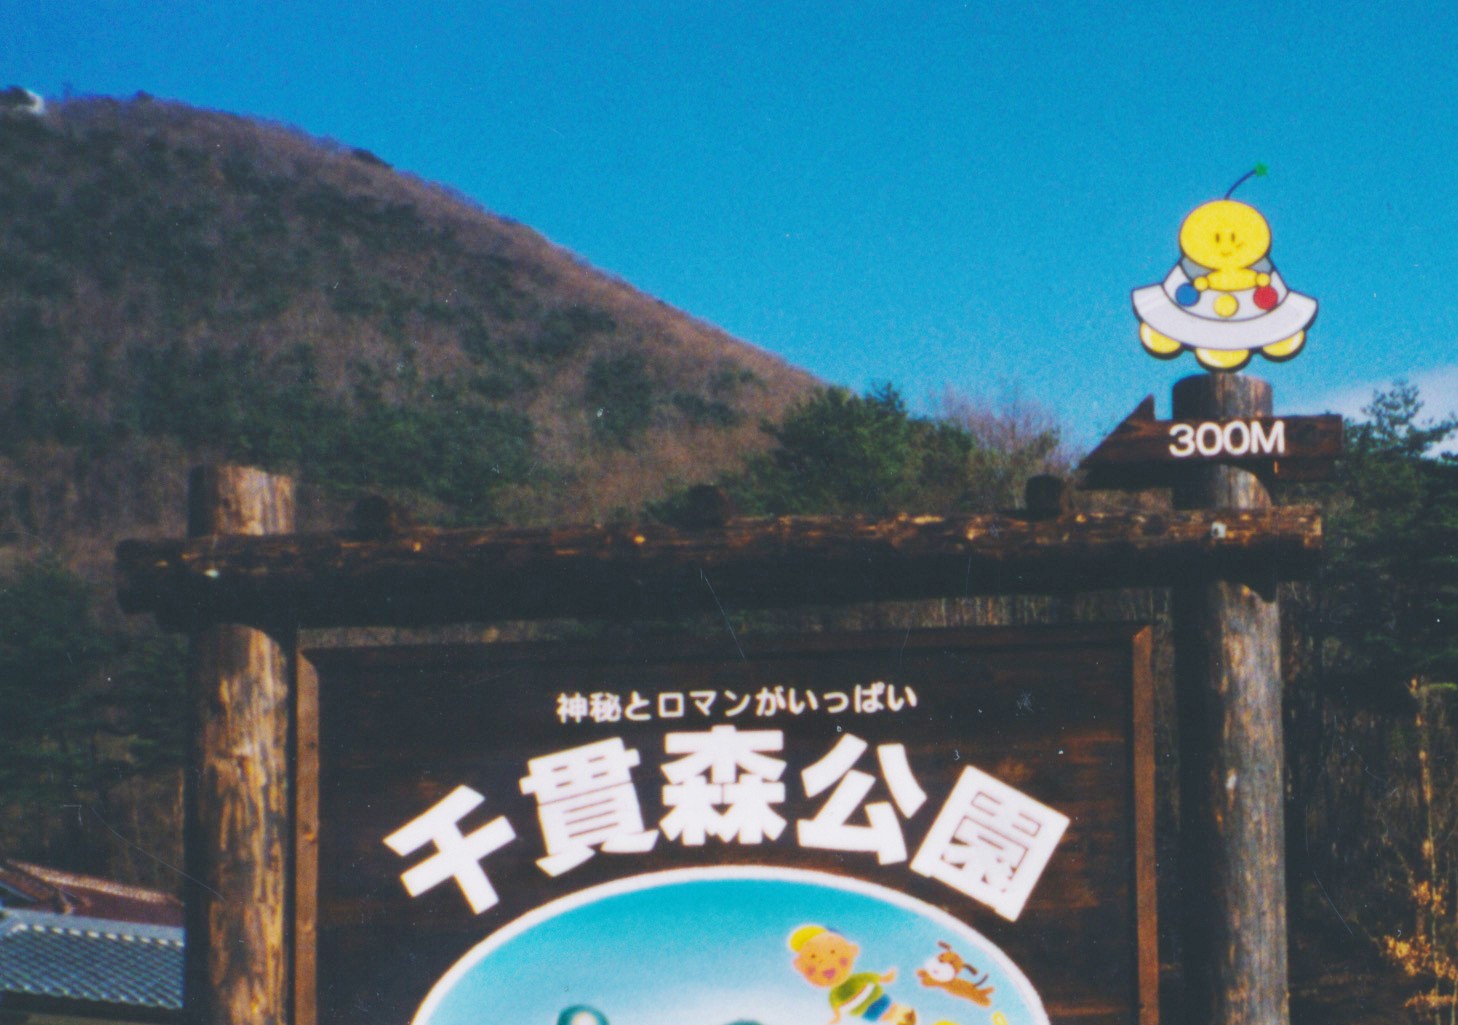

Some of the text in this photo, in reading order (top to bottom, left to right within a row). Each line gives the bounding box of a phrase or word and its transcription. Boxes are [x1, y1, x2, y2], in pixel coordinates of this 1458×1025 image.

[1168, 419, 1286, 458] 300M
[555, 681, 918, 724] 神秘とロマンがいっぱい
[382, 723, 1072, 923] 千貫森公園
